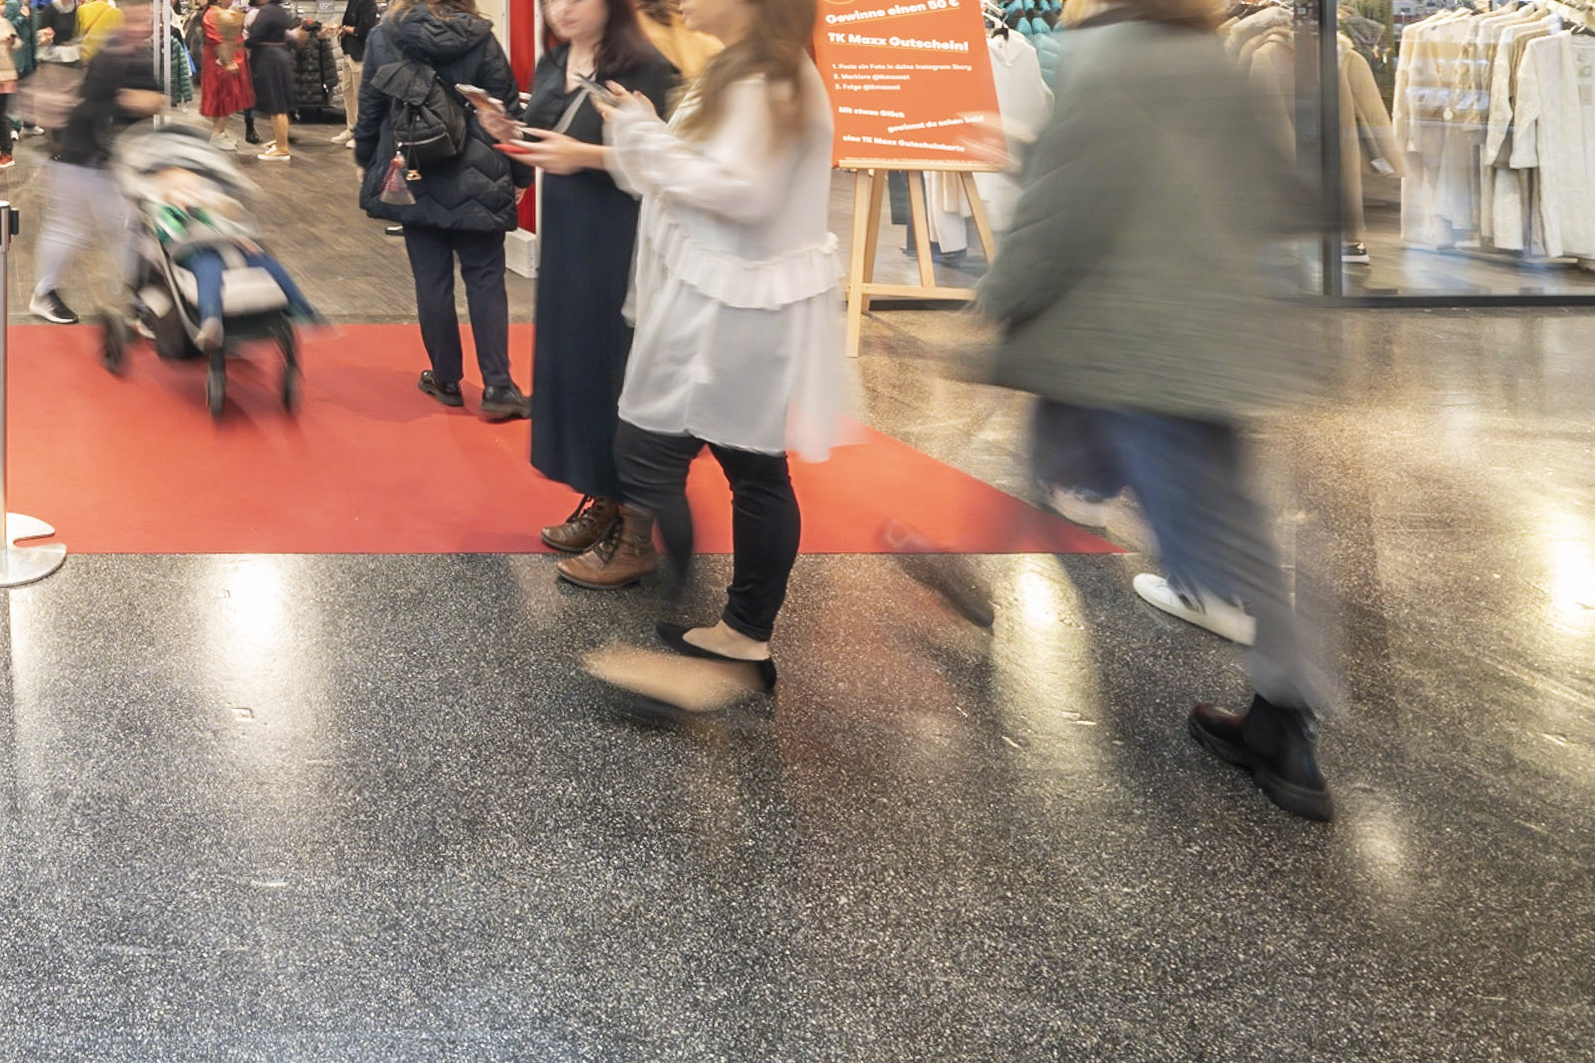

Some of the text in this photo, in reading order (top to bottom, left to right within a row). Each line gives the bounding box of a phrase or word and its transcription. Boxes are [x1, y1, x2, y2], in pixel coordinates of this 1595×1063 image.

[825, 8, 886, 25] Gewinne
[887, 3, 927, 16] einen
[828, 32, 969, 51] TK Maxx Gutschein!
[838, 106, 852, 114] Mit
[862, 135, 873, 144] TK
[874, 137, 897, 146] Maxx
